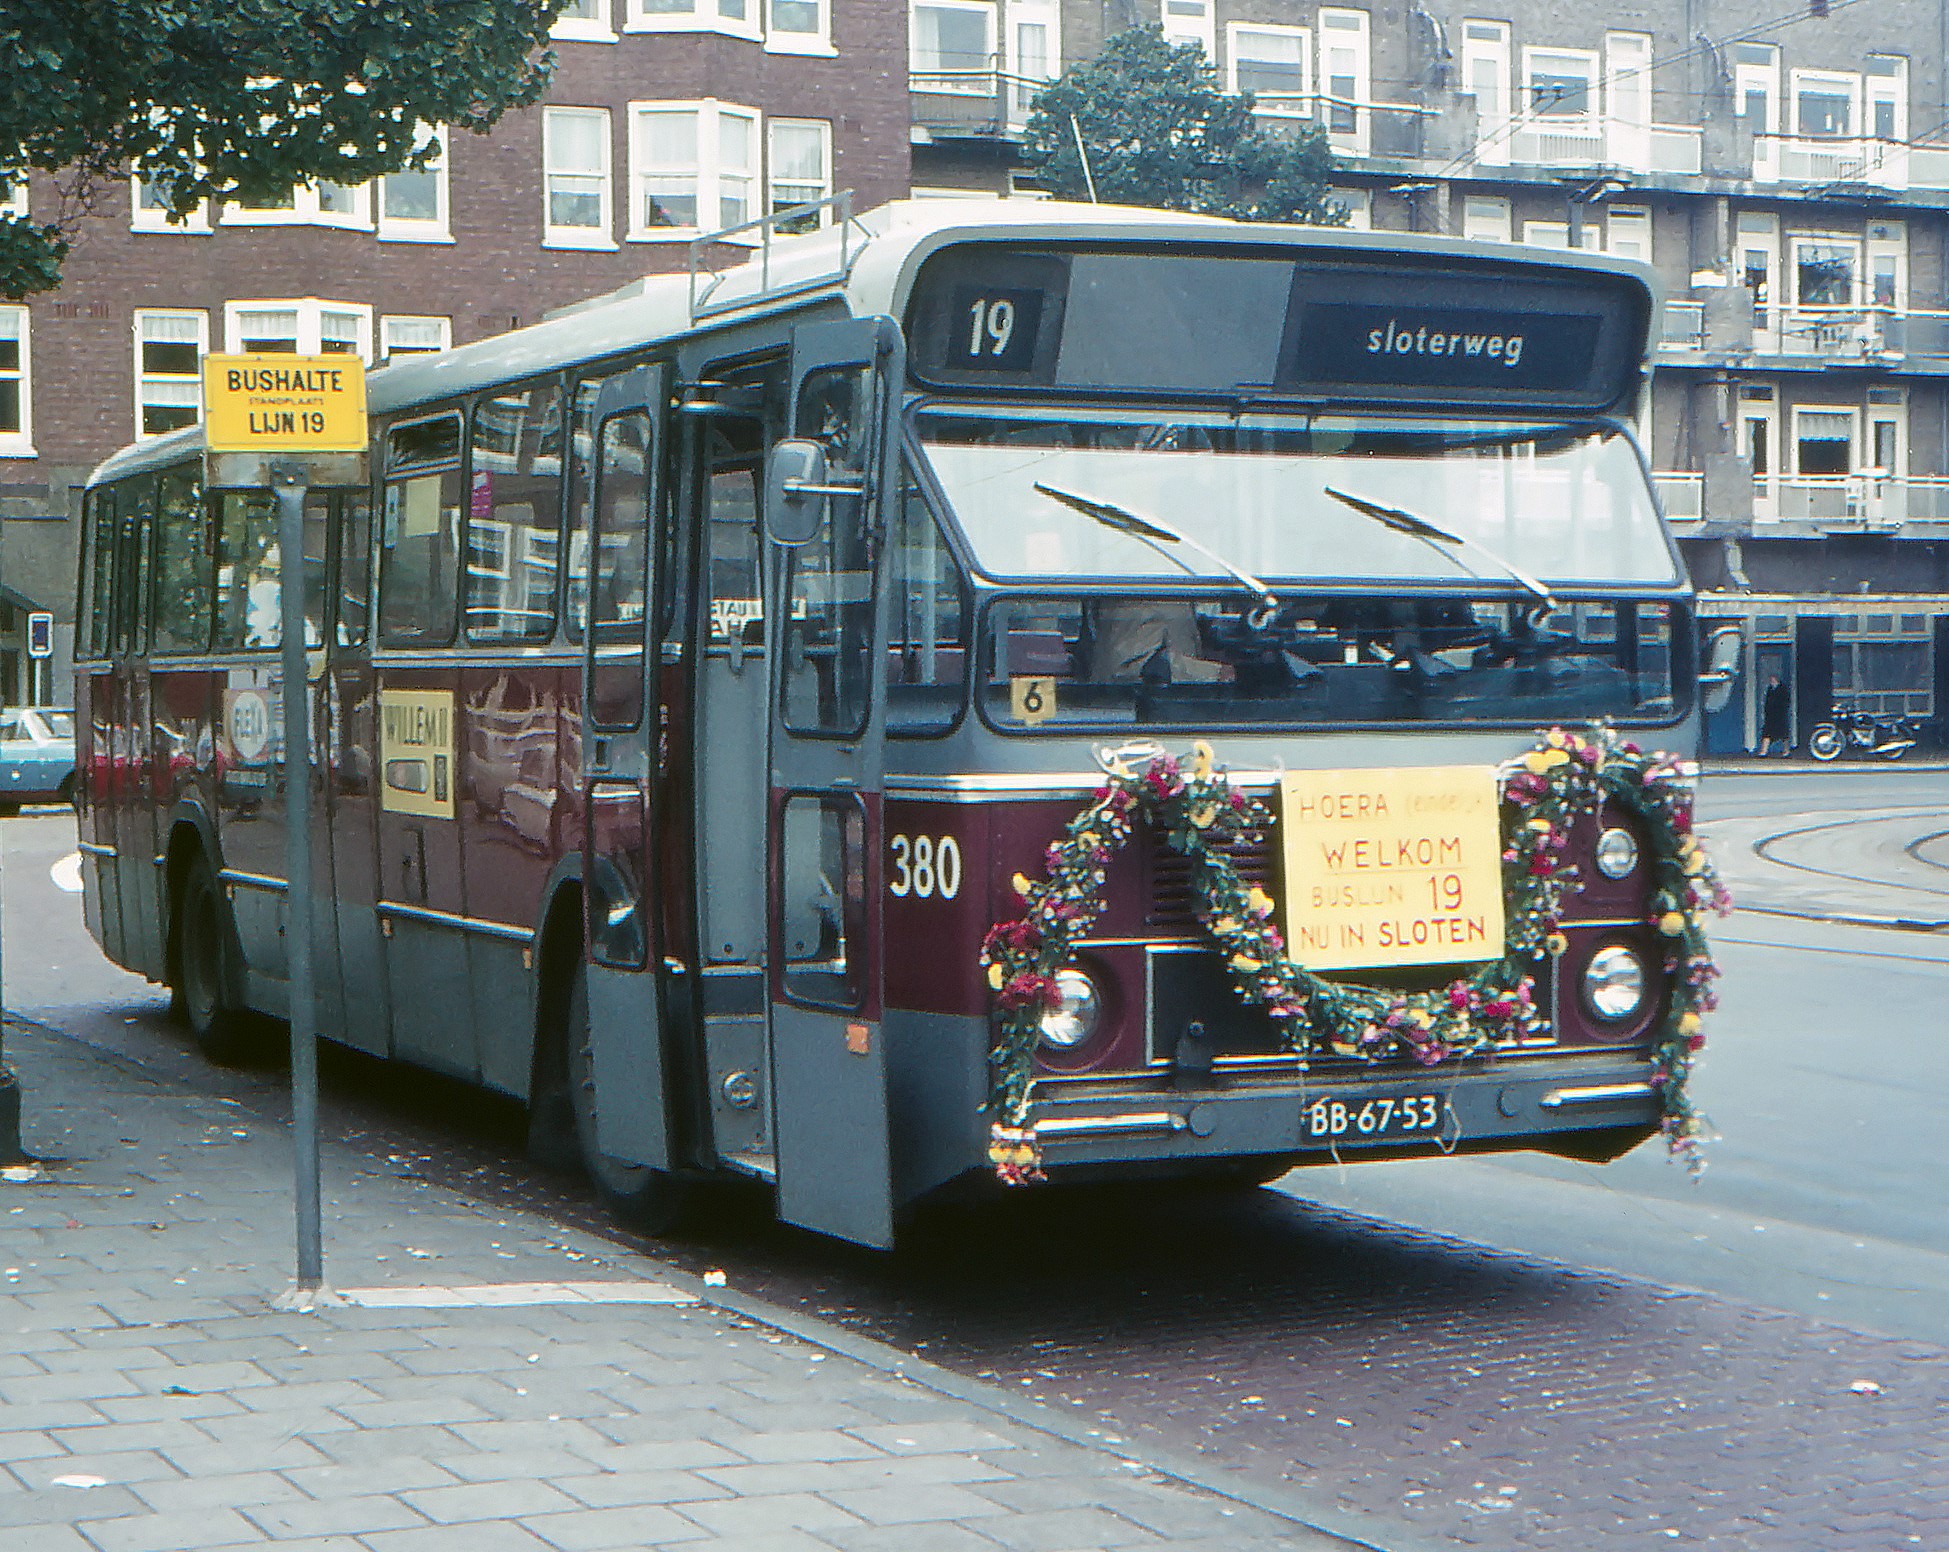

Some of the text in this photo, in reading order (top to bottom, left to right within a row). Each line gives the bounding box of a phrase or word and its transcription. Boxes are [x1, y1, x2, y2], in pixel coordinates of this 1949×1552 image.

[969, 298, 1015, 356] 19
[1367, 319, 1524, 368] sloterweg
[227, 369, 343, 392] BUSHALTE
[249, 411, 325, 434] LIJN 19
[1023, 680, 1044, 713] 6
[1300, 793, 1390, 822] HOERA
[889, 833, 961, 900] 380
[1321, 836, 1462, 869] WELKOM
[1427, 873, 1463, 912] 19
[1300, 915, 1486, 949] NU IN SLOTEN
[1310, 1095, 1438, 1136] BB-67-53
